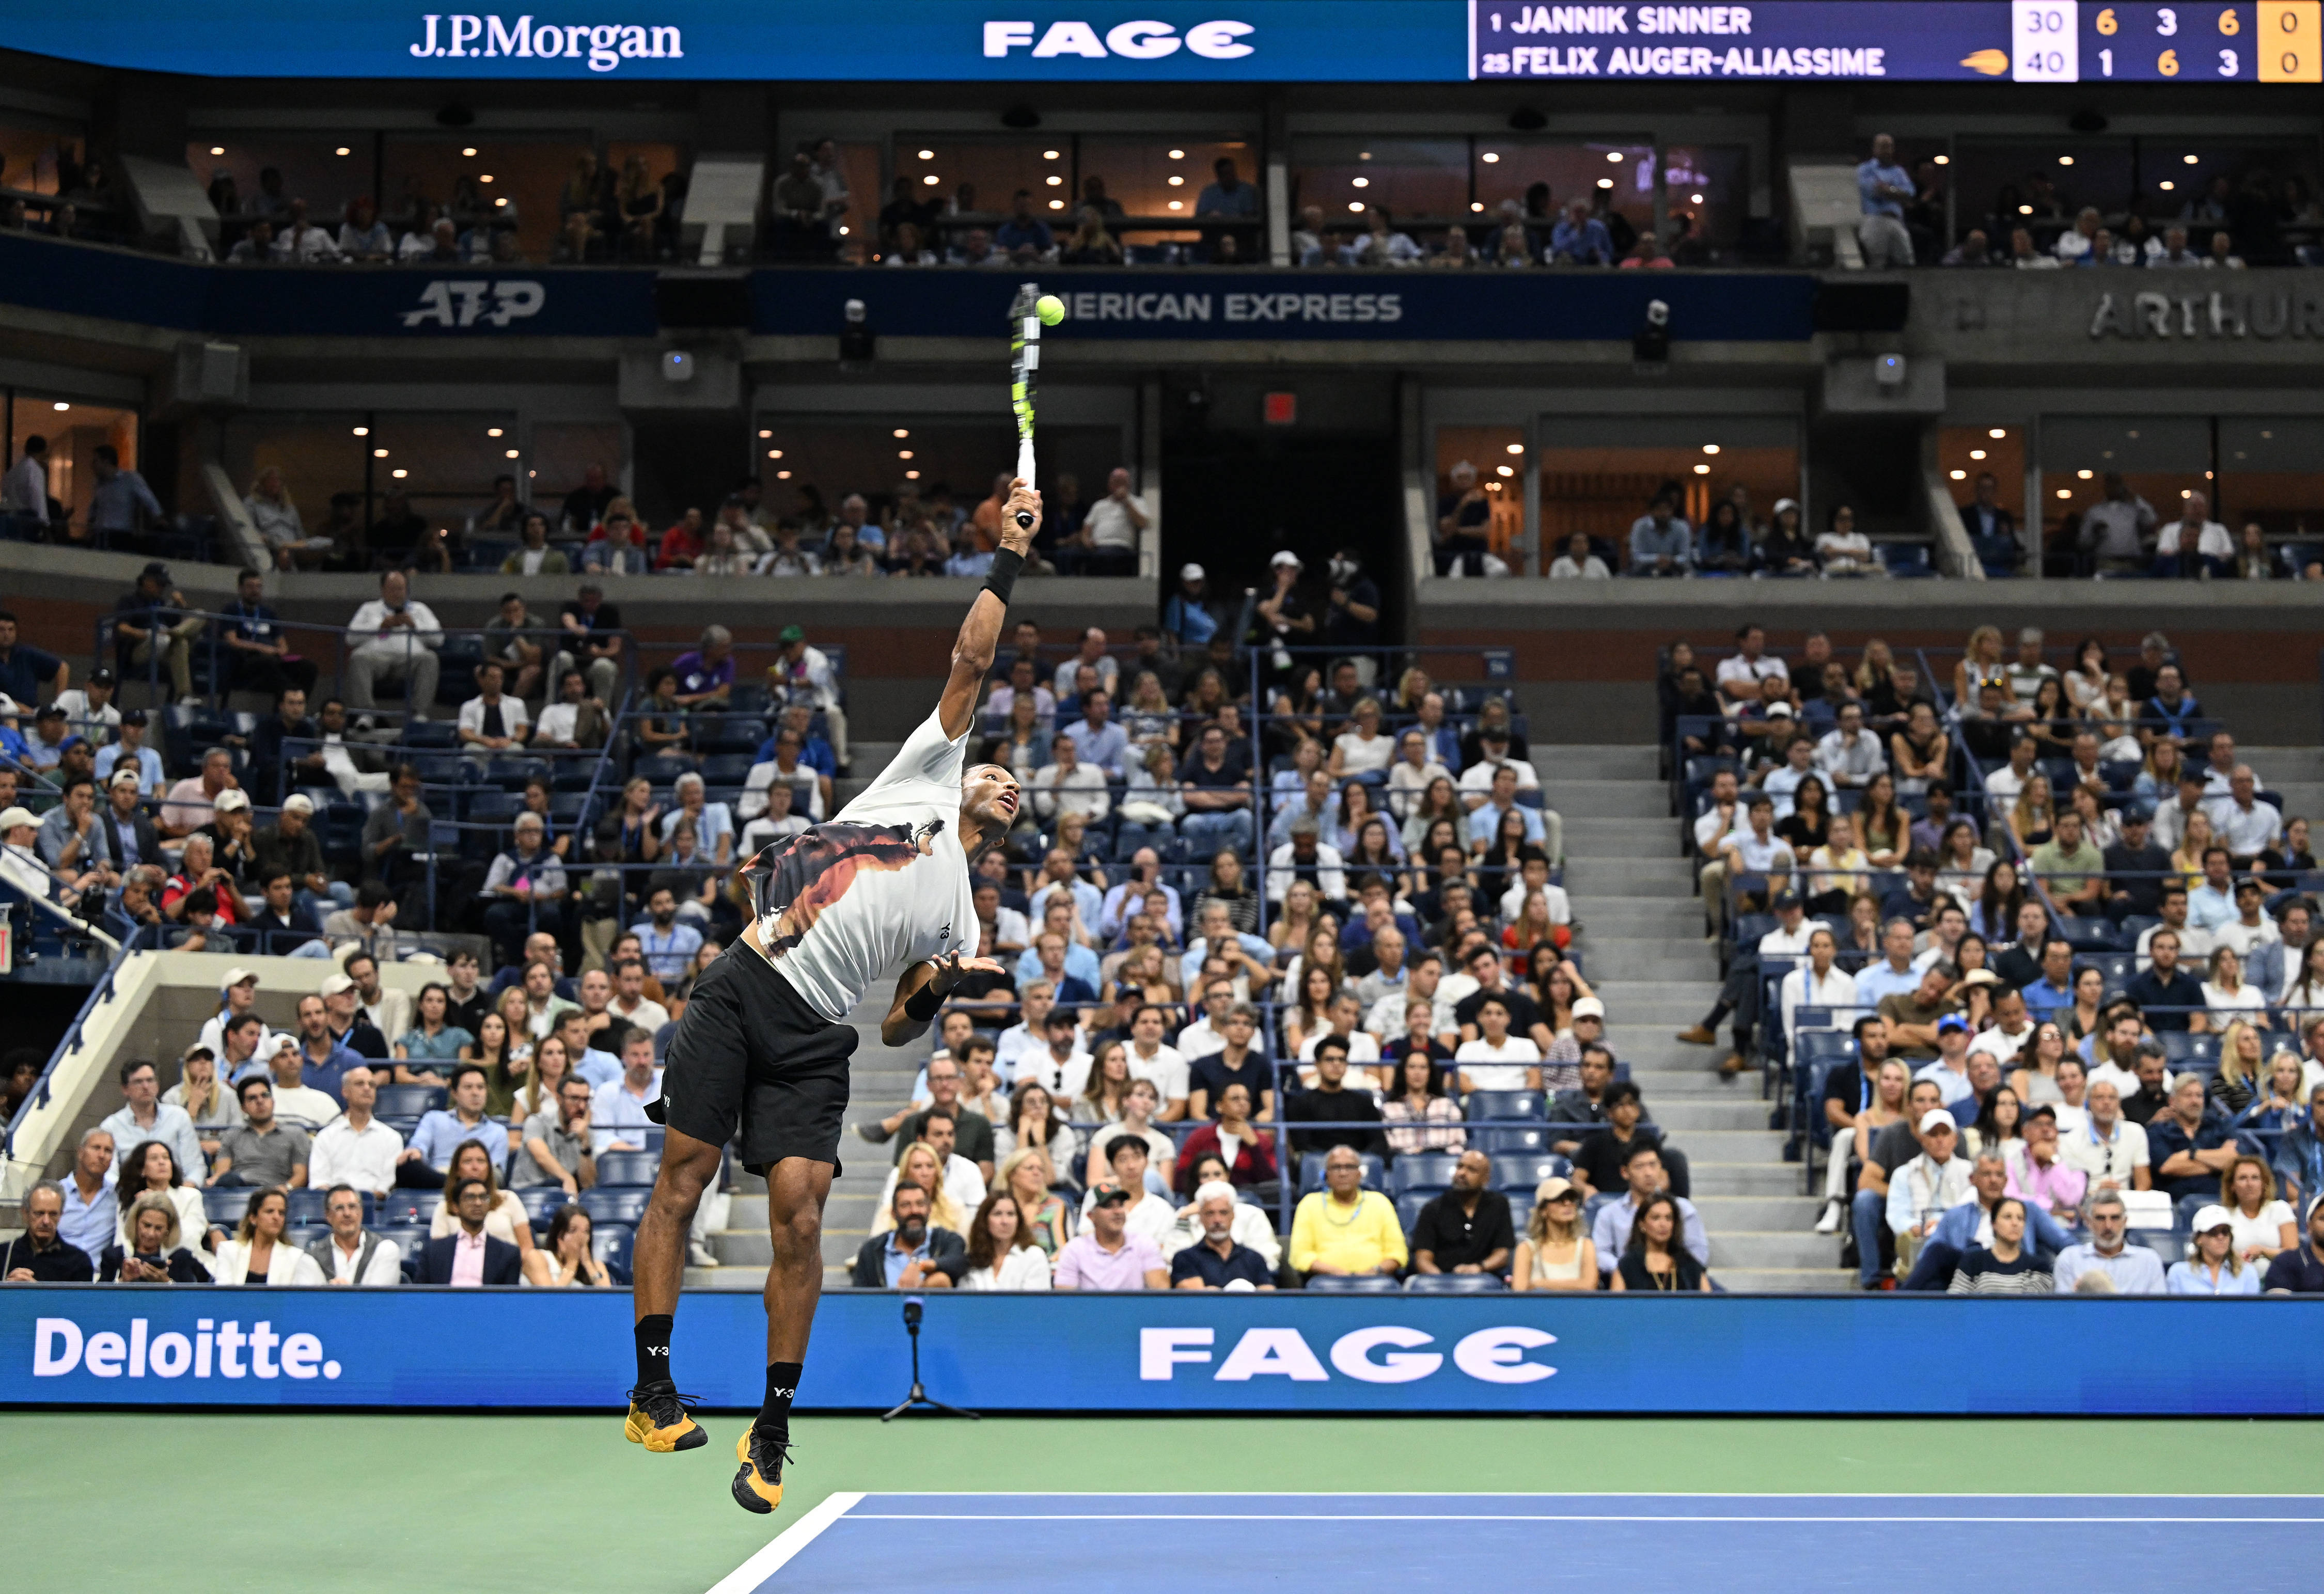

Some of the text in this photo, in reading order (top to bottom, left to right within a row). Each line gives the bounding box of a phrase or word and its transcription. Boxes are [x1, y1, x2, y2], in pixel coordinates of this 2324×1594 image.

[983, 20, 1255, 59] FAGE
[1490, 6, 2298, 36] 1 JANNIK SINNER 30 6 3 6 0
[410, 14, 684, 72] J.P.Morgan
[1482, 46, 2298, 77] 25 FELIX AUGER-ALIASSIME 40 1 6 3 0
[402, 280, 545, 327] ATP
[1224, 293, 1402, 322] EXPRESS
[2089, 290, 2324, 338] ARTHUR
[33, 1318, 342, 1379] Deloitte.
[647, 1346, 669, 1356] Y-3
[1140, 1326, 1558, 1384] FAGE
[773, 1387, 795, 1399] Y-3
